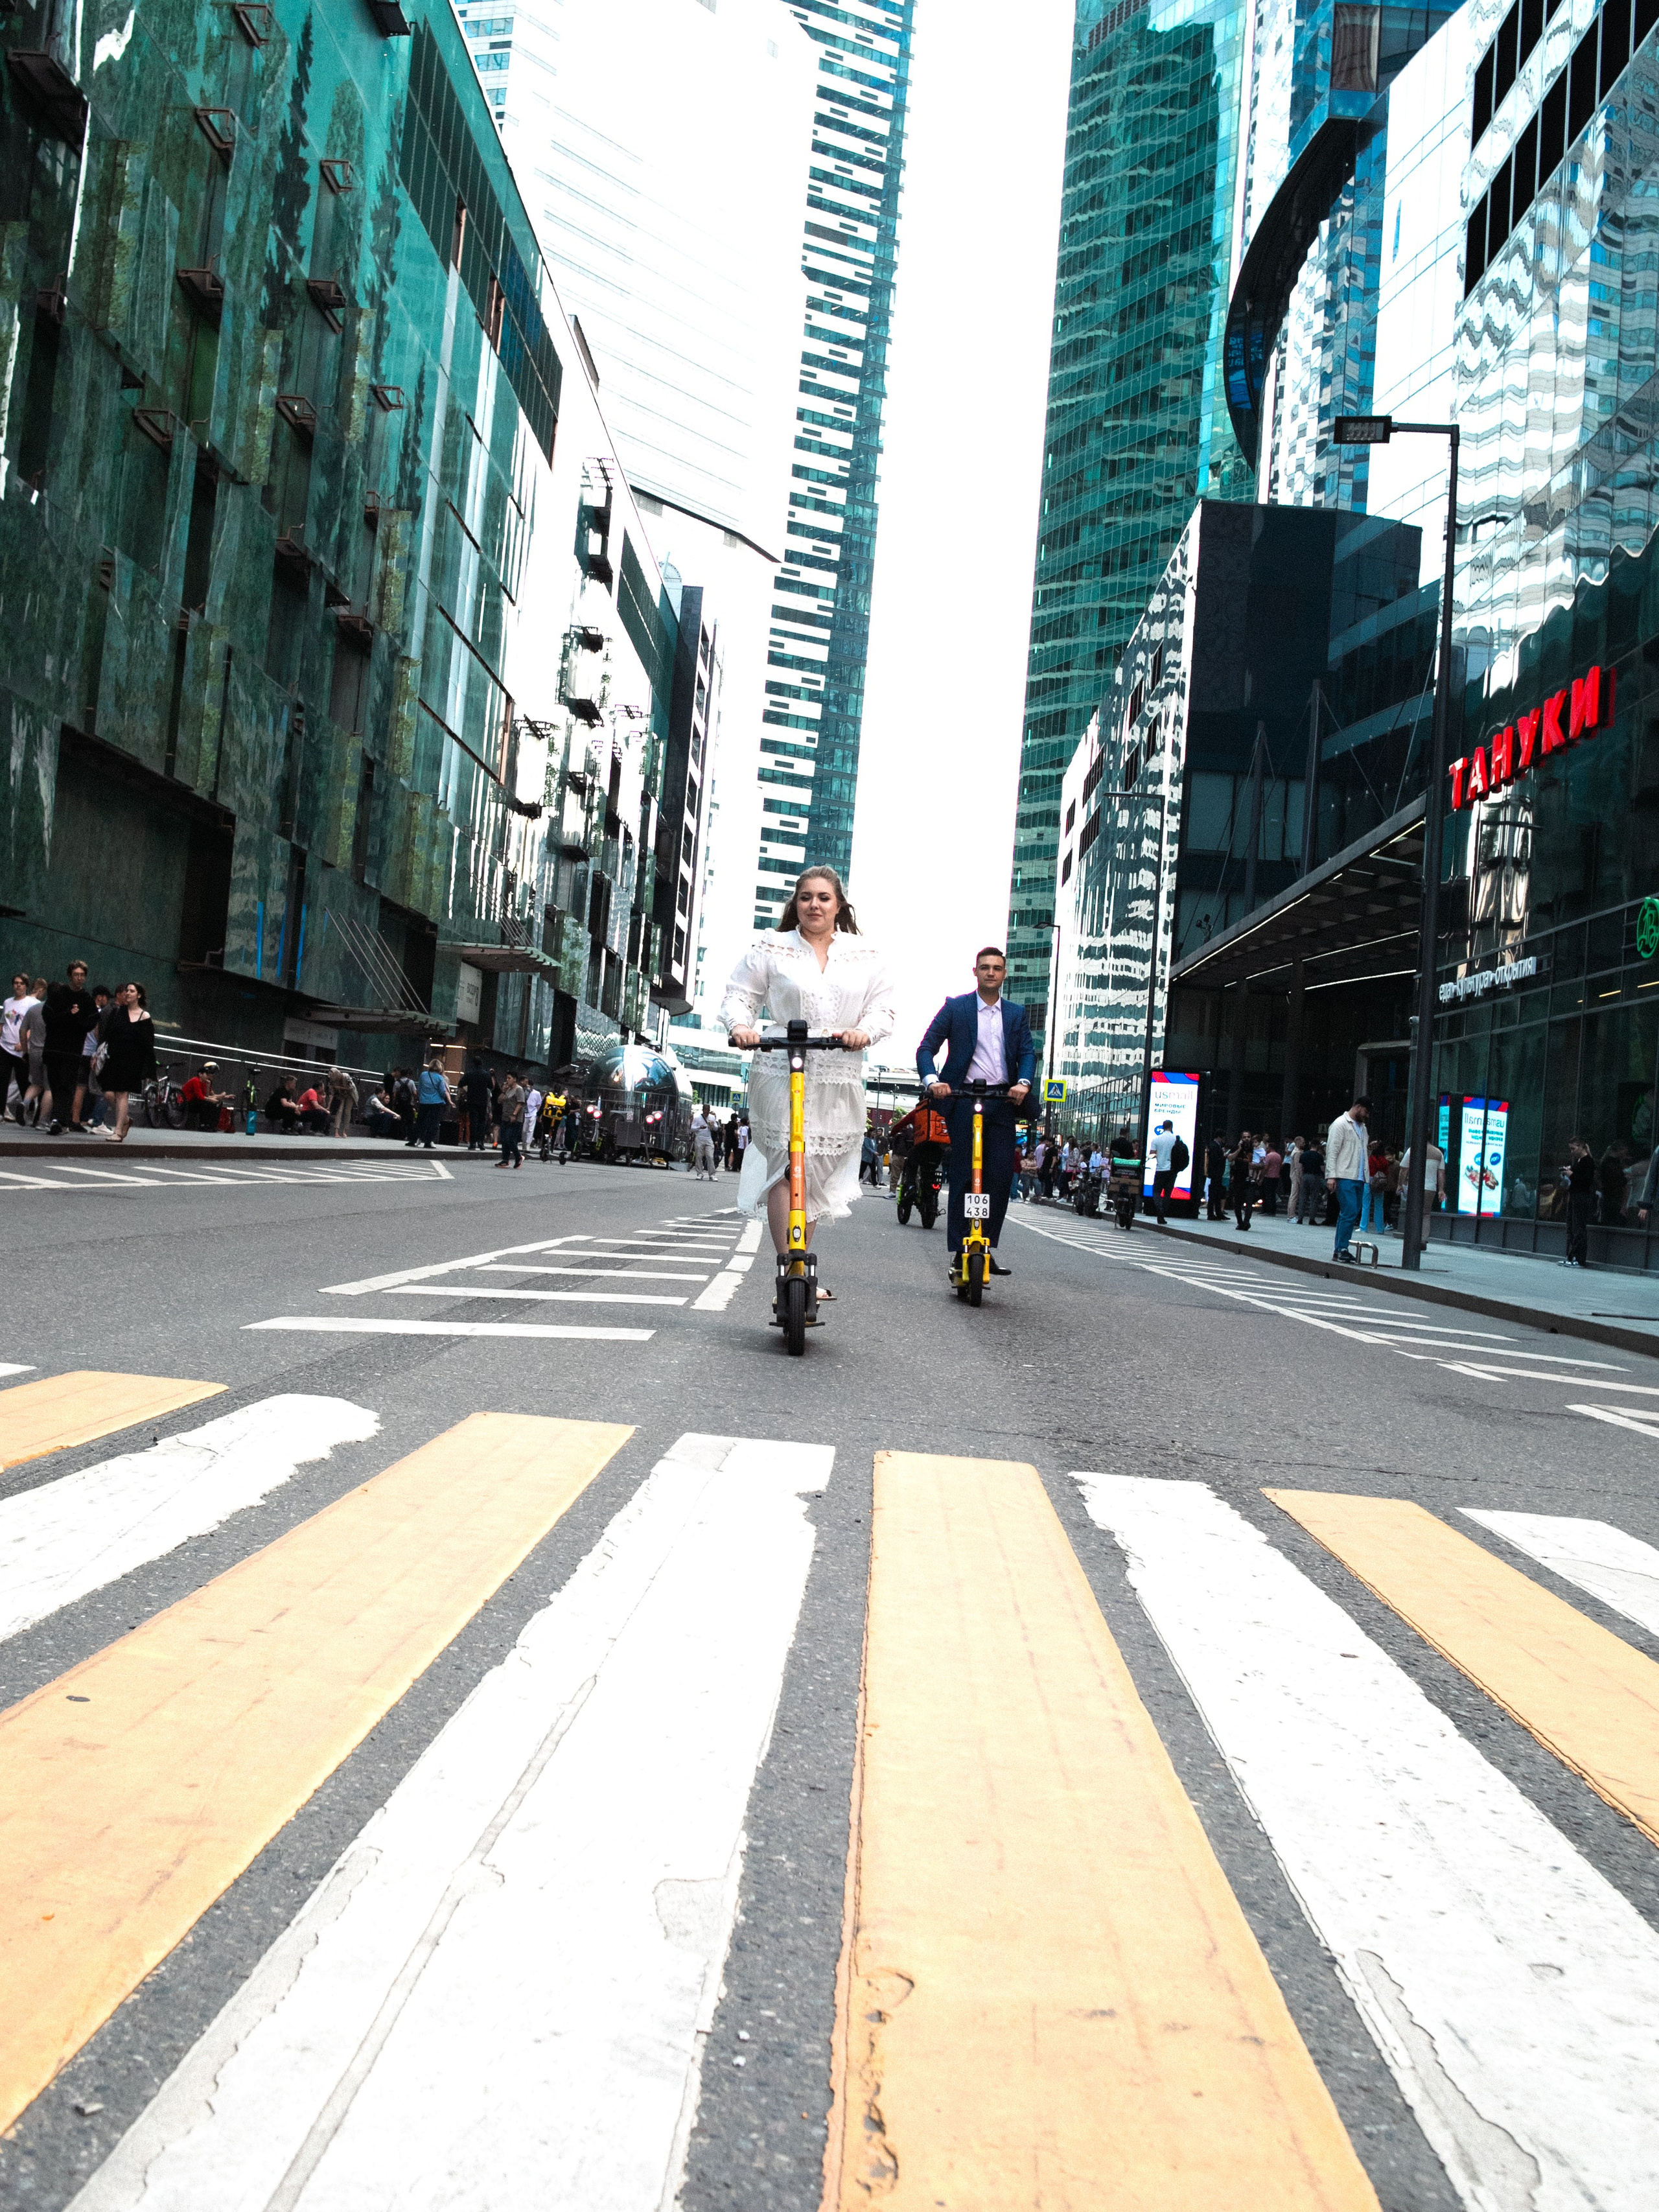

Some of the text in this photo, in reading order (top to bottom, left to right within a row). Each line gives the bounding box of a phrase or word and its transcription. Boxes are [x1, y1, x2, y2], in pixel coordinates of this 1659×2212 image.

[1449, 666, 1600, 809] ТАНУКИ
[1494, 956, 1537, 989] открытия
[1155, 1090, 1193, 1100] usmall
[967, 1195, 988, 1204] 106
[966, 1207, 988, 1217] 438
